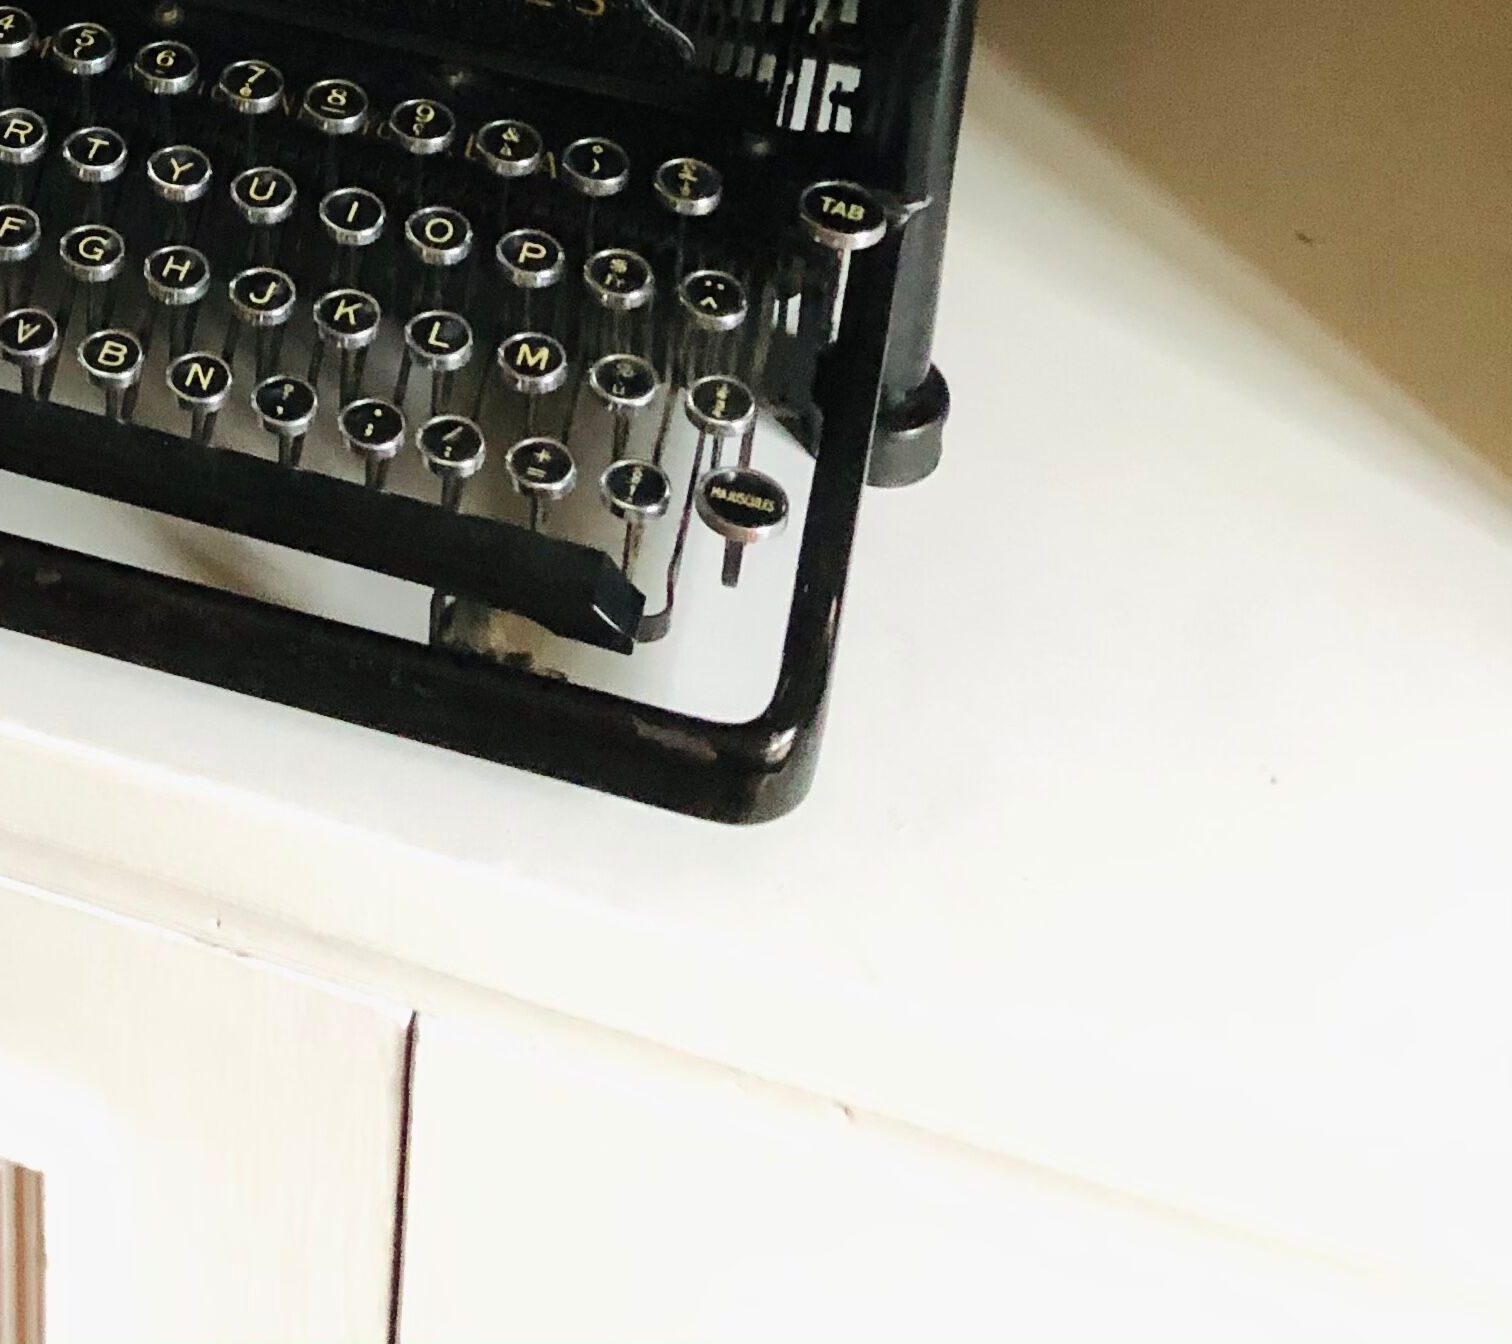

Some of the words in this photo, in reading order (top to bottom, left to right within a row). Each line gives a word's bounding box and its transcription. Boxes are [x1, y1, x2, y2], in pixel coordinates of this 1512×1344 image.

[75, 28, 98, 47] 5
[156, 50, 177, 67] 6
[248, 64, 266, 84] 7
[327, 88, 348, 106] 8
[415, 103, 435, 123] 9
[3, 117, 34, 145] R
[83, 136, 110, 160] T
[170, 157, 194, 182] Y
[248, 176, 277, 201] U
[424, 217, 454, 244] O
[518, 240, 547, 264] P
[821, 196, 866, 221] TAB
[78, 235, 112, 262] G
[161, 255, 192, 282] H
[248, 281, 272, 304] J
[333, 298, 358, 326] K
[427, 321, 450, 349] L
[515, 343, 550, 371] M
[17, 318, 41, 344] V
[97, 340, 128, 367] B
[184, 362, 215, 391] N
[710, 485, 776, 512] MAJUSCULES
